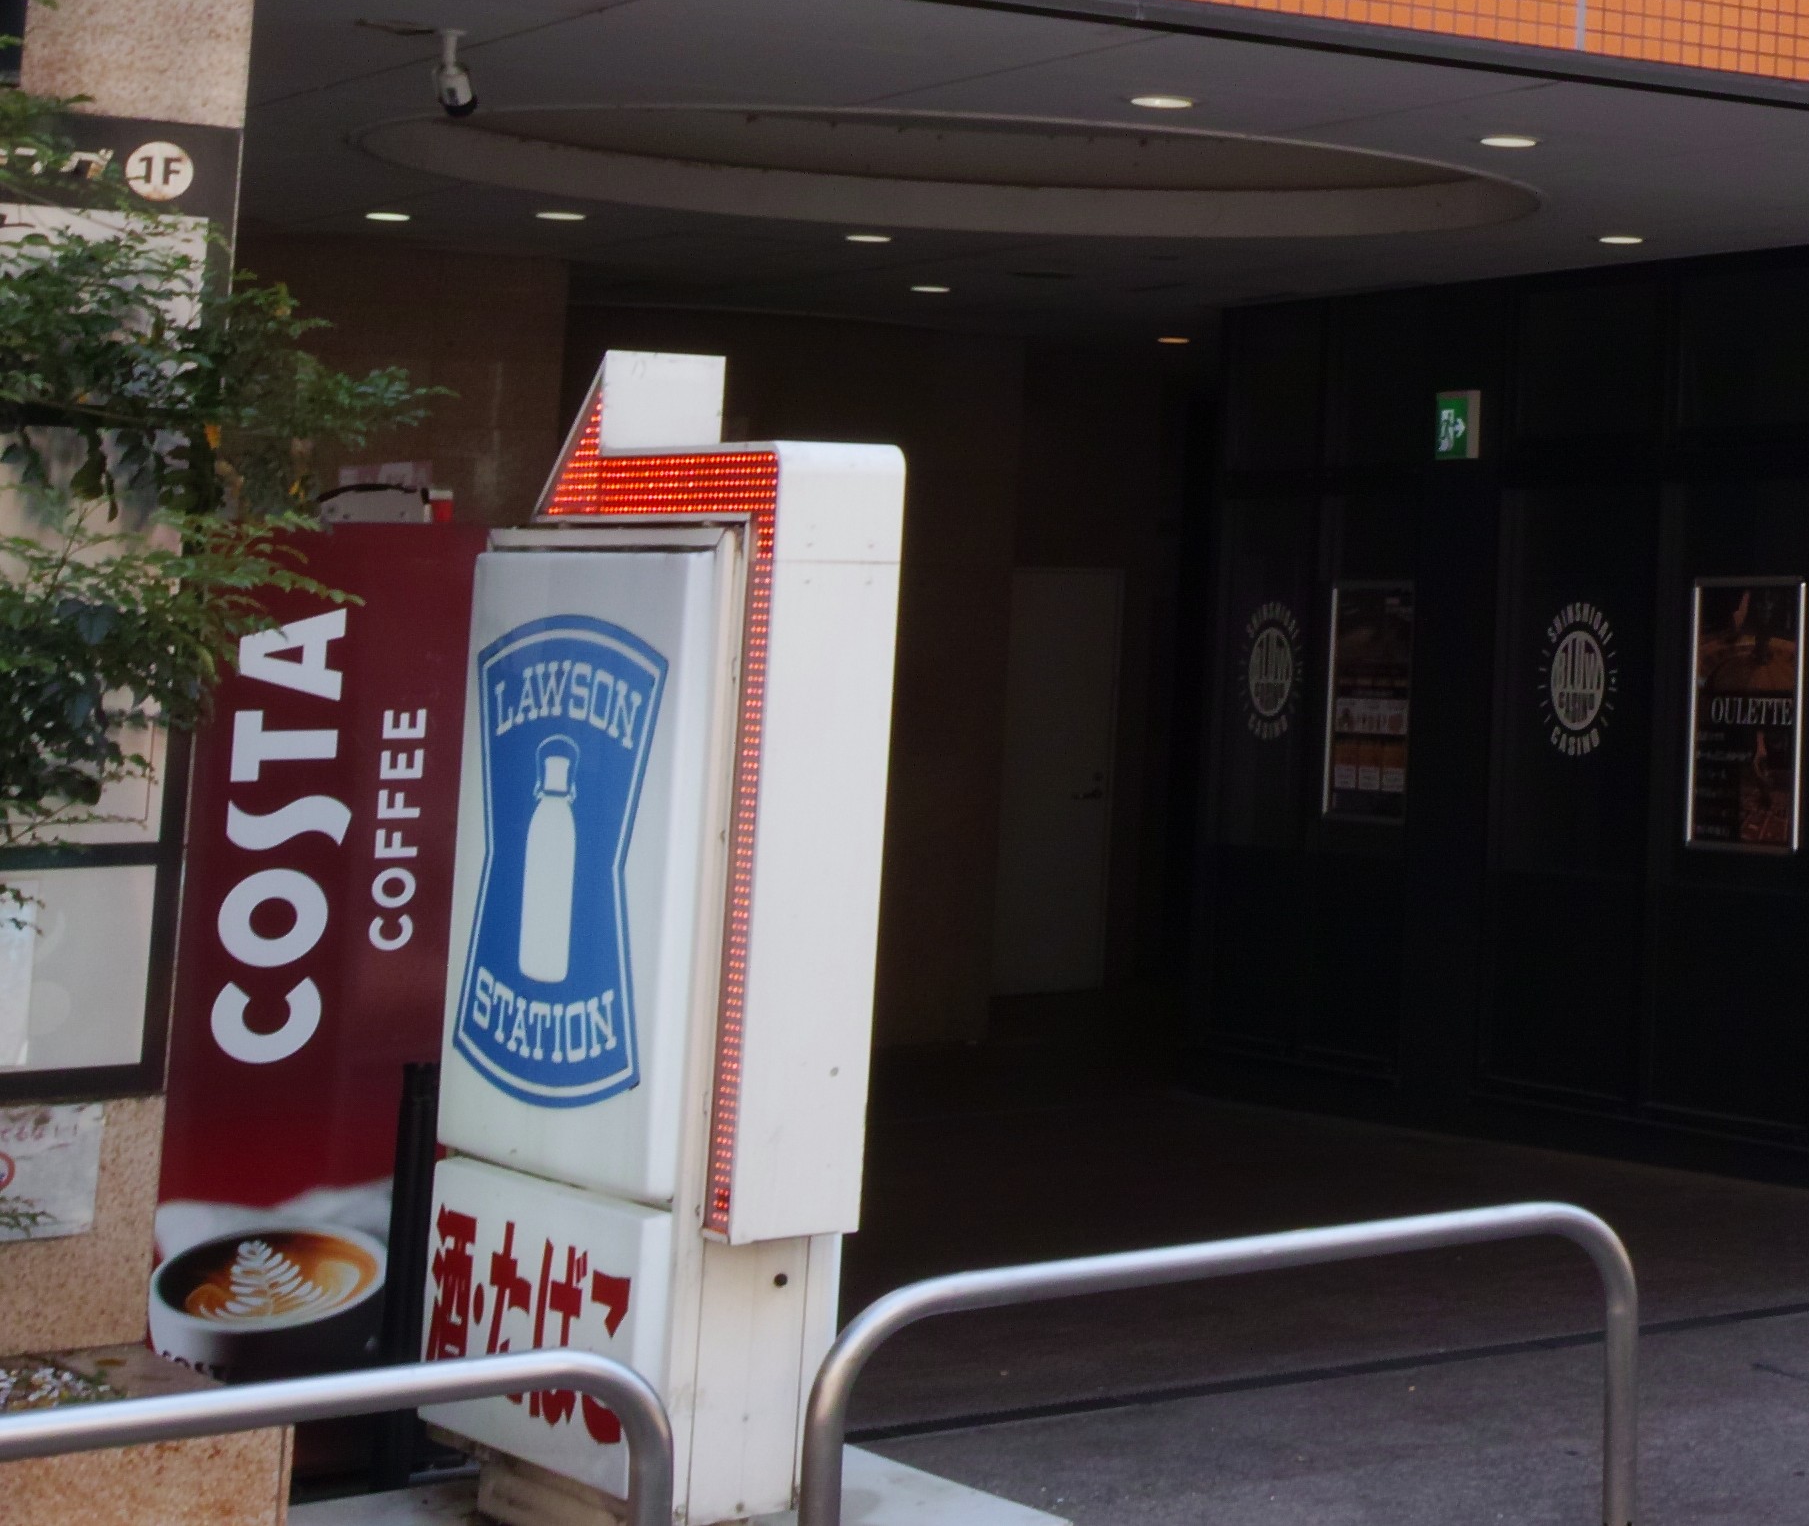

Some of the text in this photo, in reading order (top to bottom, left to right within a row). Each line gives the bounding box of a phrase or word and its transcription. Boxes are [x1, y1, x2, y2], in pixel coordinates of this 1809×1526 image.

[139, 155, 182, 186] 1F
[494, 660, 642, 750] LAWSON
[211, 608, 353, 1064] COSTA
[369, 709, 427, 951] COFFEE
[473, 966, 618, 1064] STATION
[426, 1203, 631, 1444] 酒・たばこ
